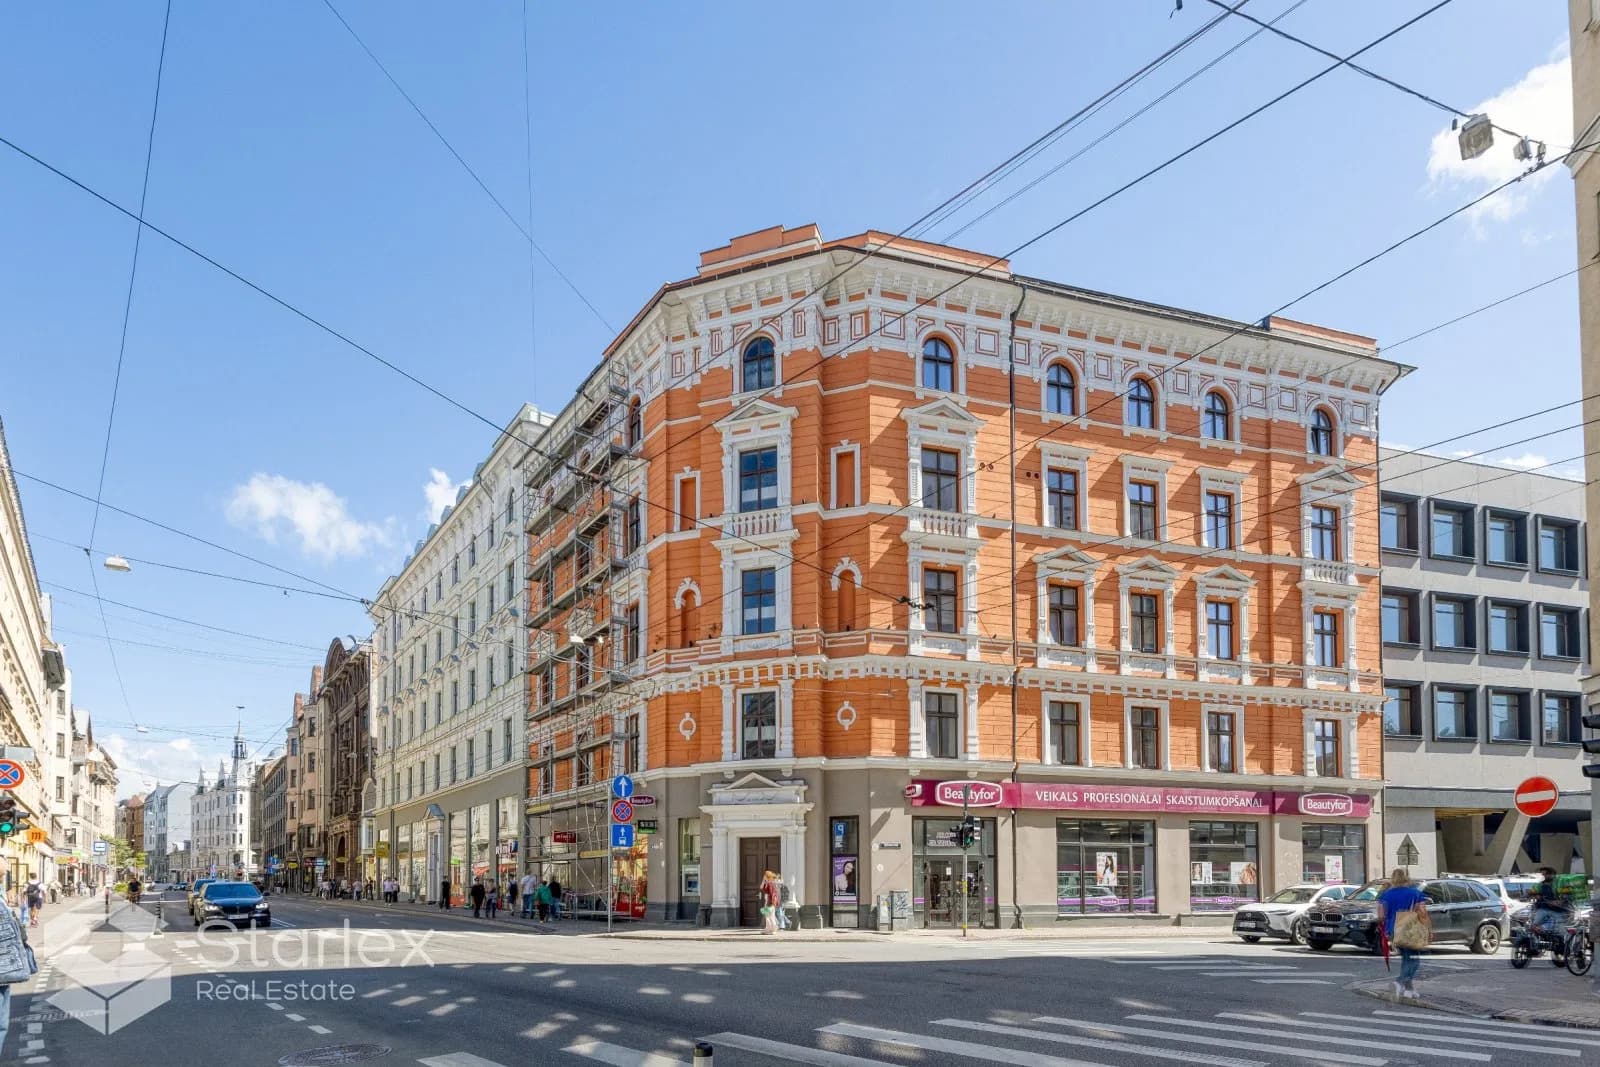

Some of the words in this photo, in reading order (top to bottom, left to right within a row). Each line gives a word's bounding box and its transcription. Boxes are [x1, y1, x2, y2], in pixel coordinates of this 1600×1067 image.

[944, 787, 995, 803] Beatyfor
[1035, 791, 1078, 802] VEIKALS
[1083, 792, 1161, 804] PROFESIONĀLAI
[1166, 793, 1263, 808] SKAISTUMKOPŠANAI
[1307, 799, 1347, 811] Beautyfor
